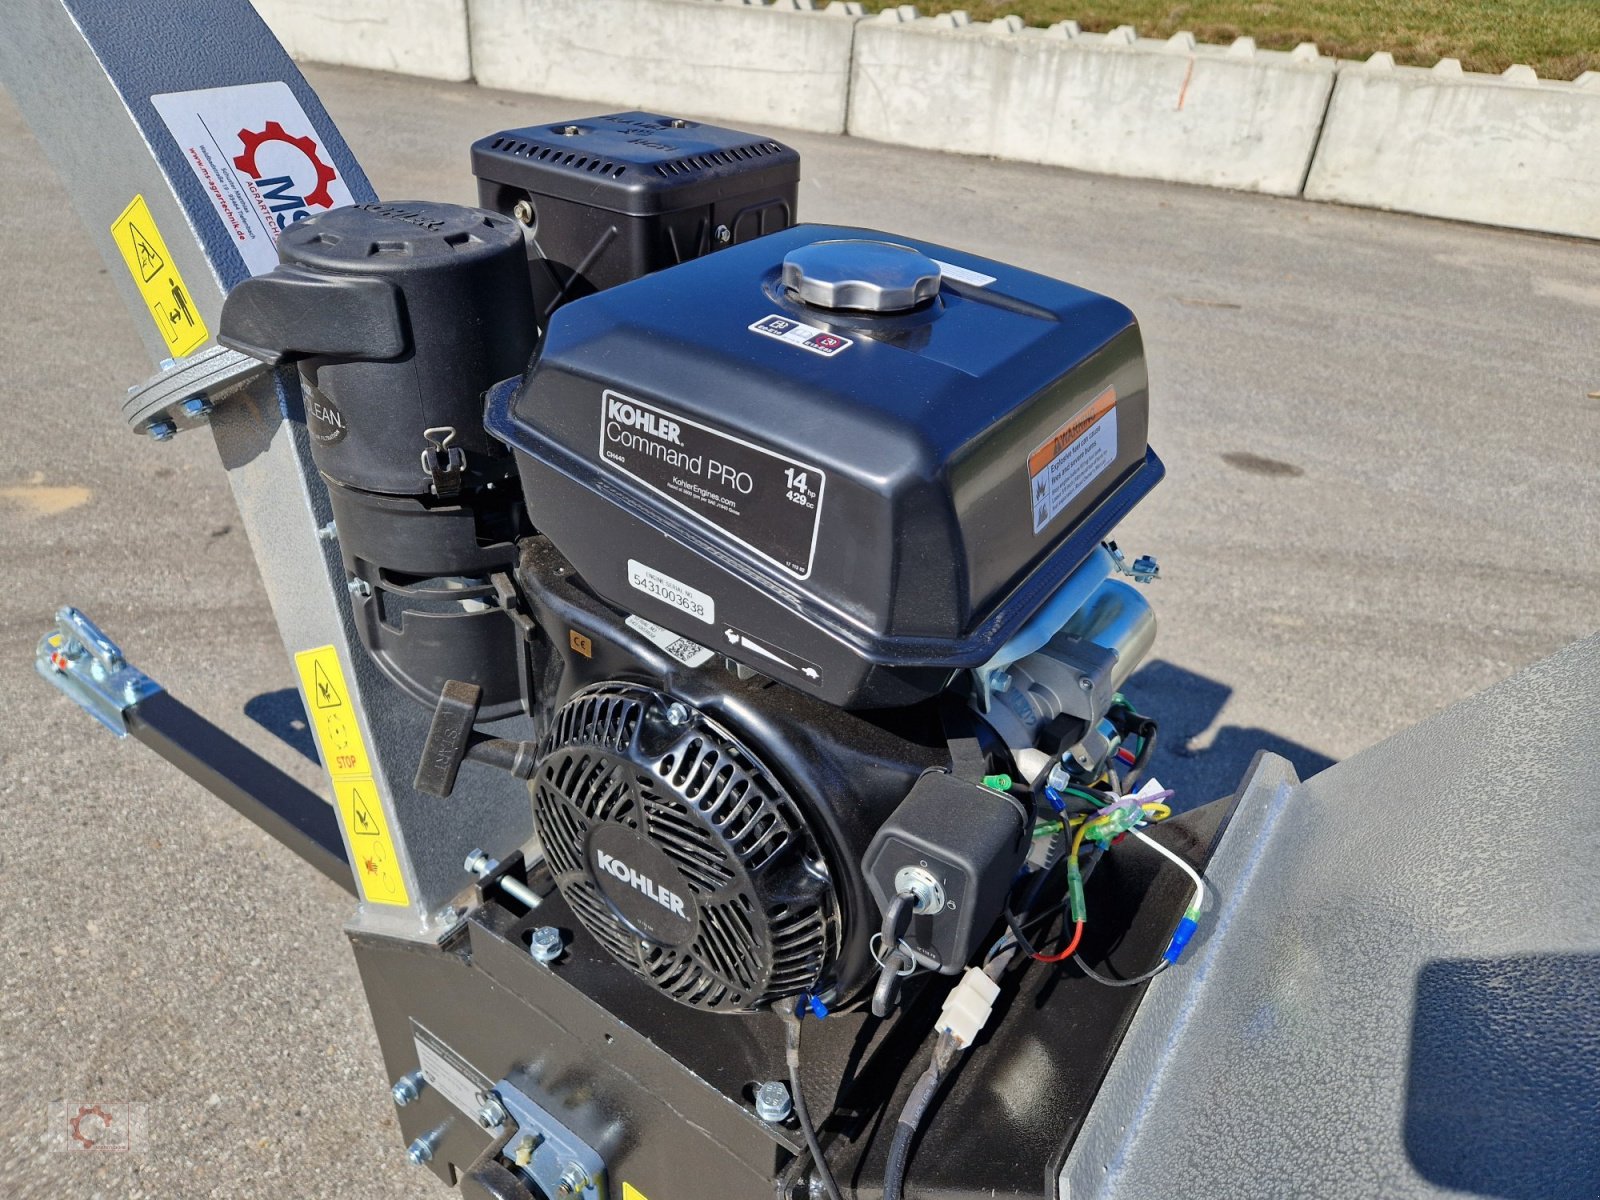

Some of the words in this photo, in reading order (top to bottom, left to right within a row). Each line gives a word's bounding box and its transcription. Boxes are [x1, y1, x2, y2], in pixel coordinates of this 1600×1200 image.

[189, 147, 246, 240] www.ms-agrartechnik.de
[607, 398, 682, 446] KOHLER
[606, 450, 626, 463] CH440
[606, 421, 702, 475] Command
[707, 459, 753, 494] PRO
[1050, 450, 1072, 473] Explosive
[1072, 443, 1081, 456] fuel
[1081, 436, 1089, 446] can
[1051, 470, 1061, 484] fires
[1062, 463, 1071, 475] and
[1070, 451, 1084, 467] severe
[1084, 441, 1097, 455] burns
[672, 476, 736, 508] KohlerEngines.com
[784, 467, 808, 493] 14
[807, 489, 817, 499] hp
[785, 490, 807, 506] 429
[634, 574, 704, 617] 5431003638
[336, 755, 356, 769] STOP
[597, 849, 686, 919] KOHLER
